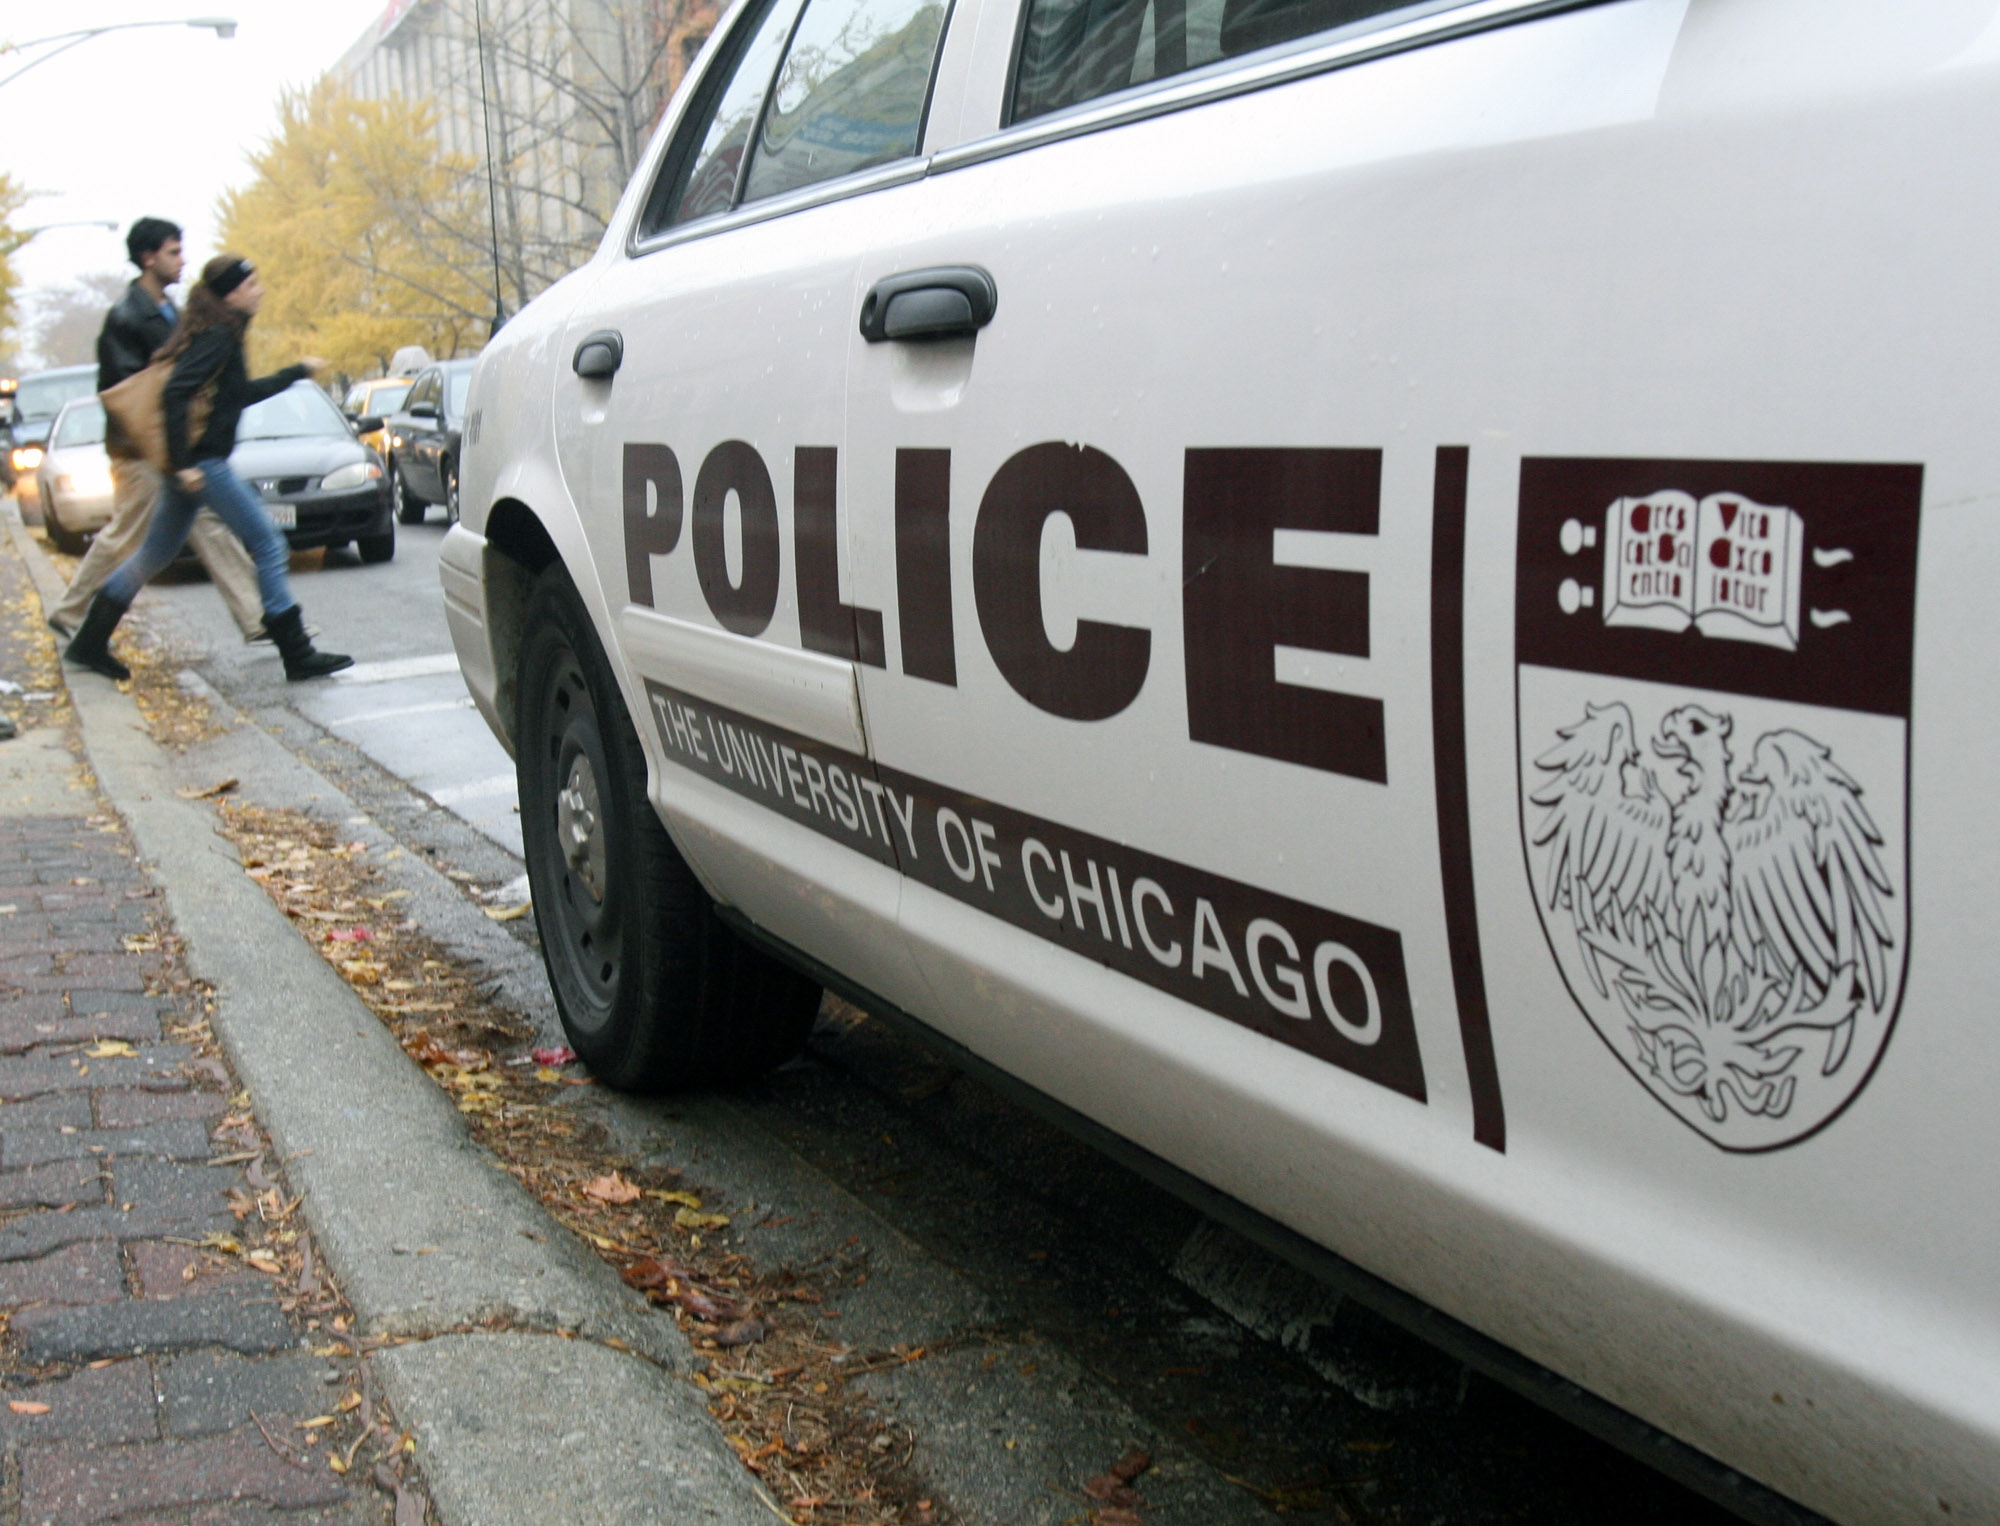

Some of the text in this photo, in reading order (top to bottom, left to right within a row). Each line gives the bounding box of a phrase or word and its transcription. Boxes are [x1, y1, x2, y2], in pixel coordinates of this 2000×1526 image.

[623, 440, 1387, 786] POLICE
[654, 694, 1382, 1046] THE UNIVERSITY OF CHICAGO
